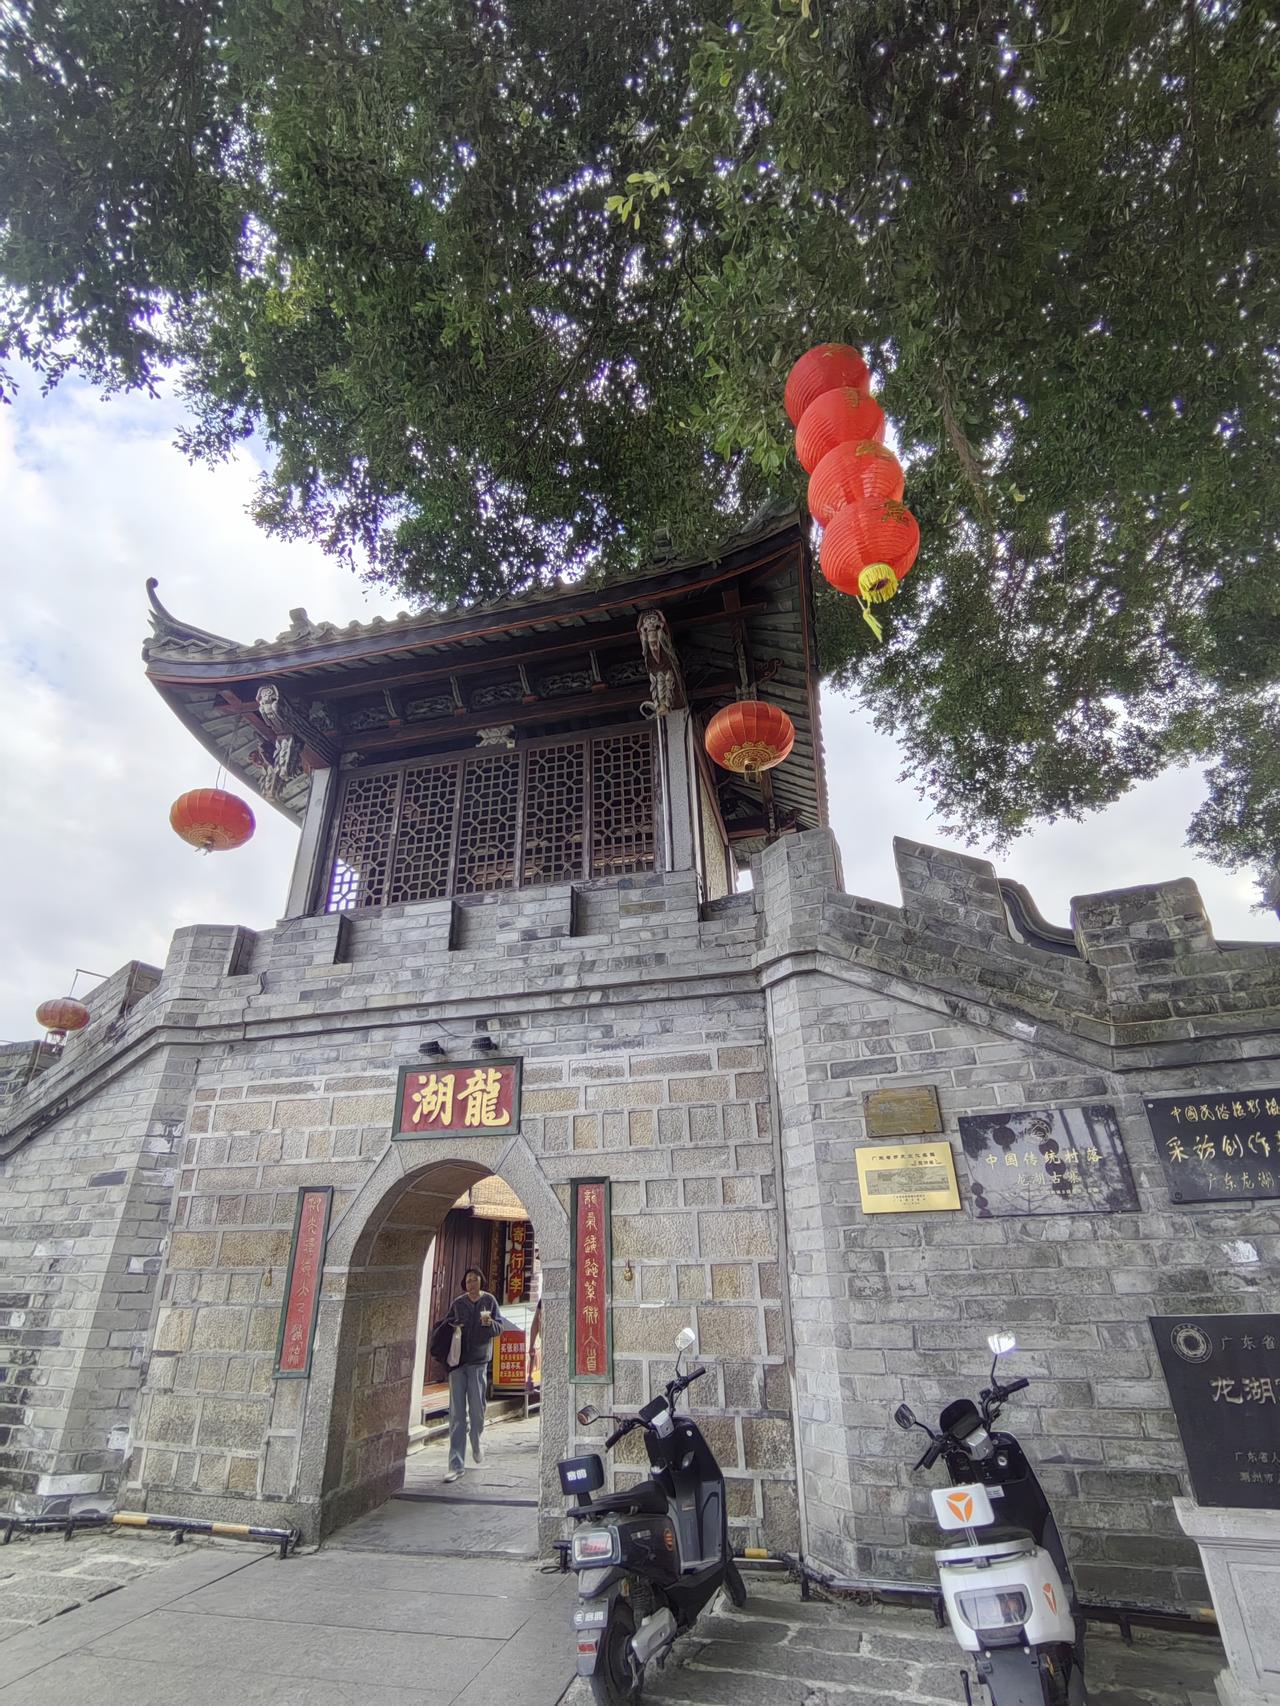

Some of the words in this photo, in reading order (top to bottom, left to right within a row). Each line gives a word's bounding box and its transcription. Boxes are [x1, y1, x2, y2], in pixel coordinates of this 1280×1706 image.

[984, 1147, 1103, 1169] 中国传统村落
[1165, 1130, 1280, 1163] 采访创作
[1209, 1376, 1280, 1405] 龙湖
